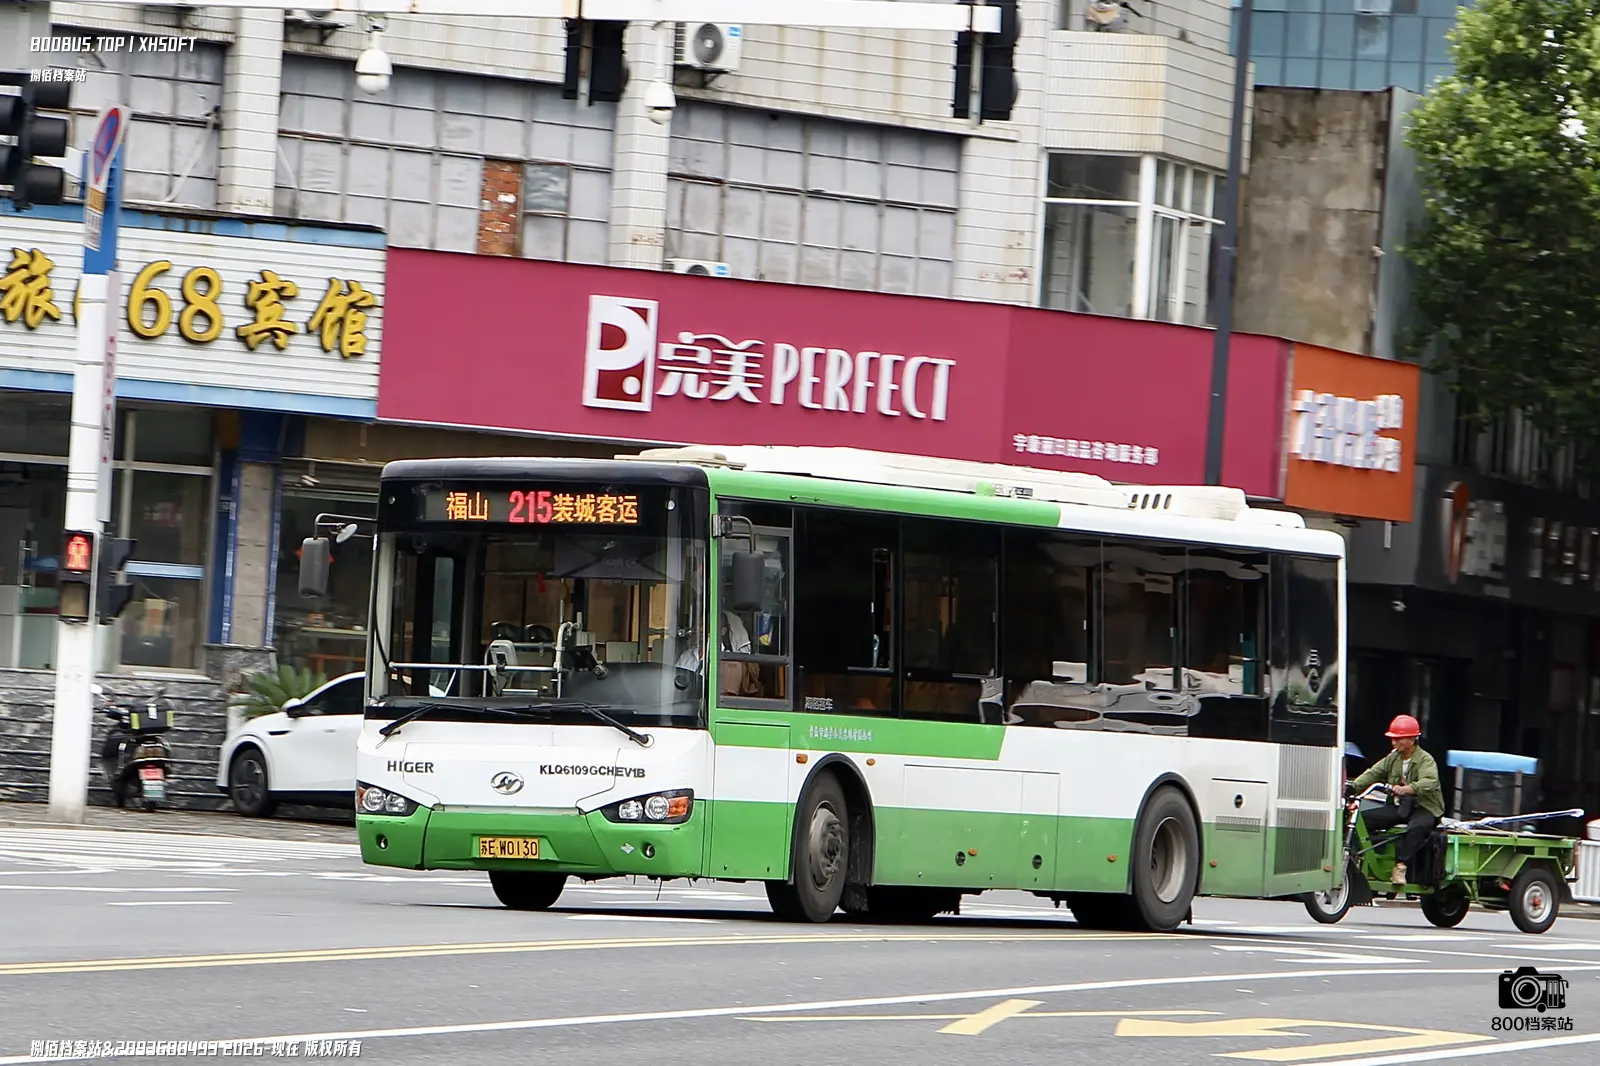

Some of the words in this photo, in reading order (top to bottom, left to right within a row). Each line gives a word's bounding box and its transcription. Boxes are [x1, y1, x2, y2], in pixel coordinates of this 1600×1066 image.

[655, 331, 766, 404] 完美
[769, 342, 957, 421] PERFECT
[446, 491, 489, 521] 福山
[508, 490, 553, 524] 215
[552, 493, 639, 523] 装城客运
[386, 760, 435, 774] HIGER
[539, 763, 647, 779] KLQ6109GCHEV1B
